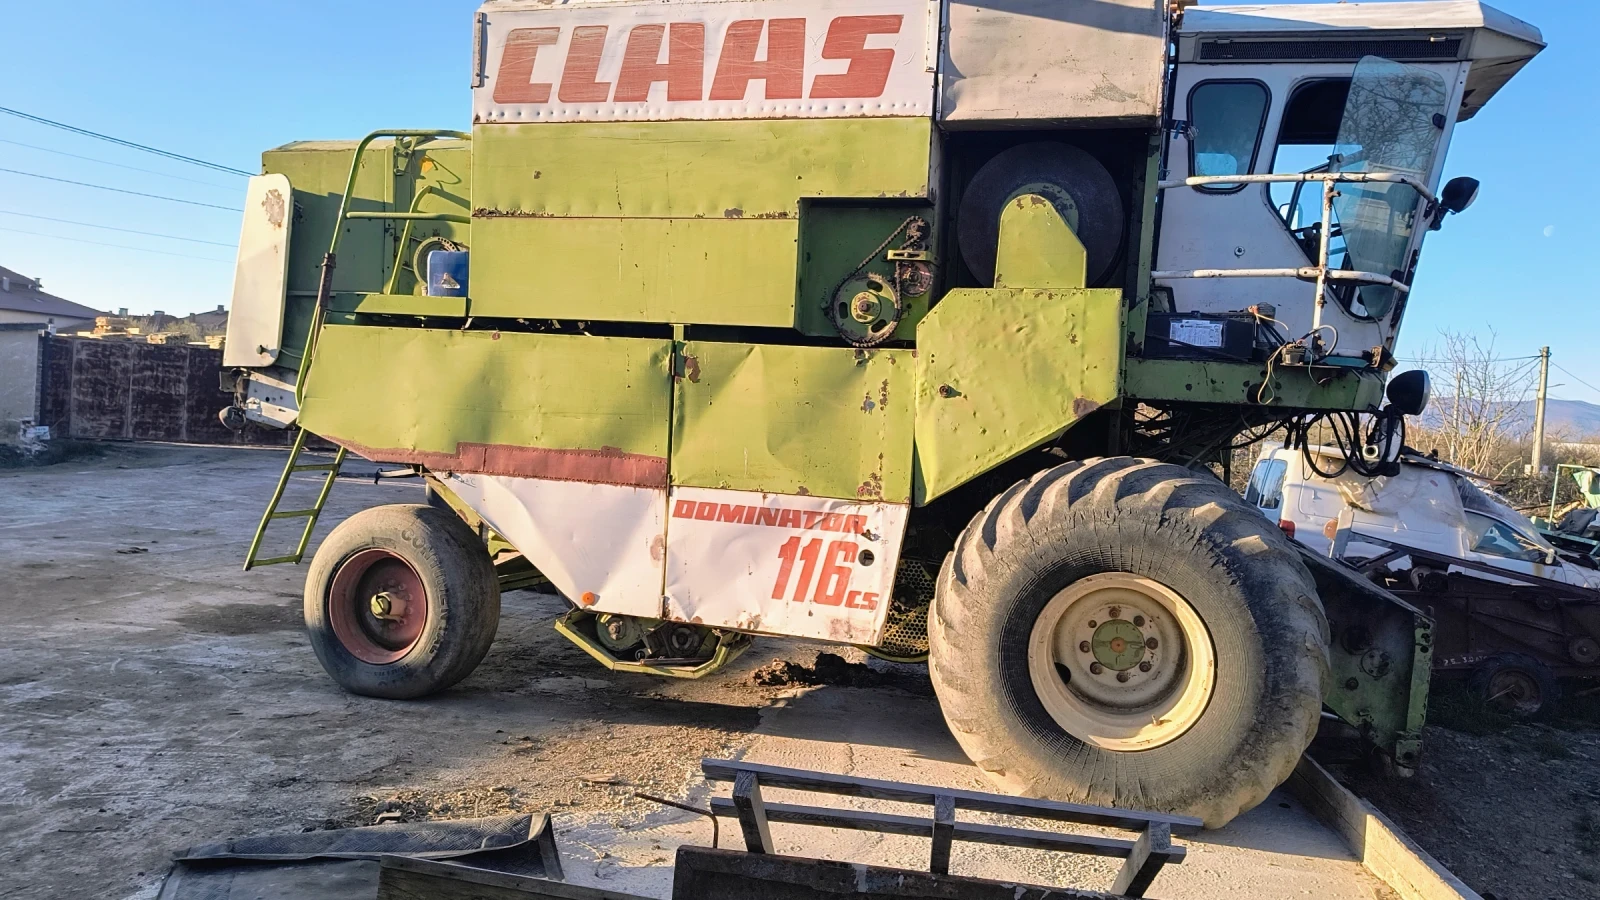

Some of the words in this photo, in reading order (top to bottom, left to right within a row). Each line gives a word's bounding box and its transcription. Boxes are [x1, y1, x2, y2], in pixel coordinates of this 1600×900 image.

[493, 15, 904, 104] CLAAS
[672, 499, 868, 534] DOMINATOR
[771, 535, 859, 607] 116
